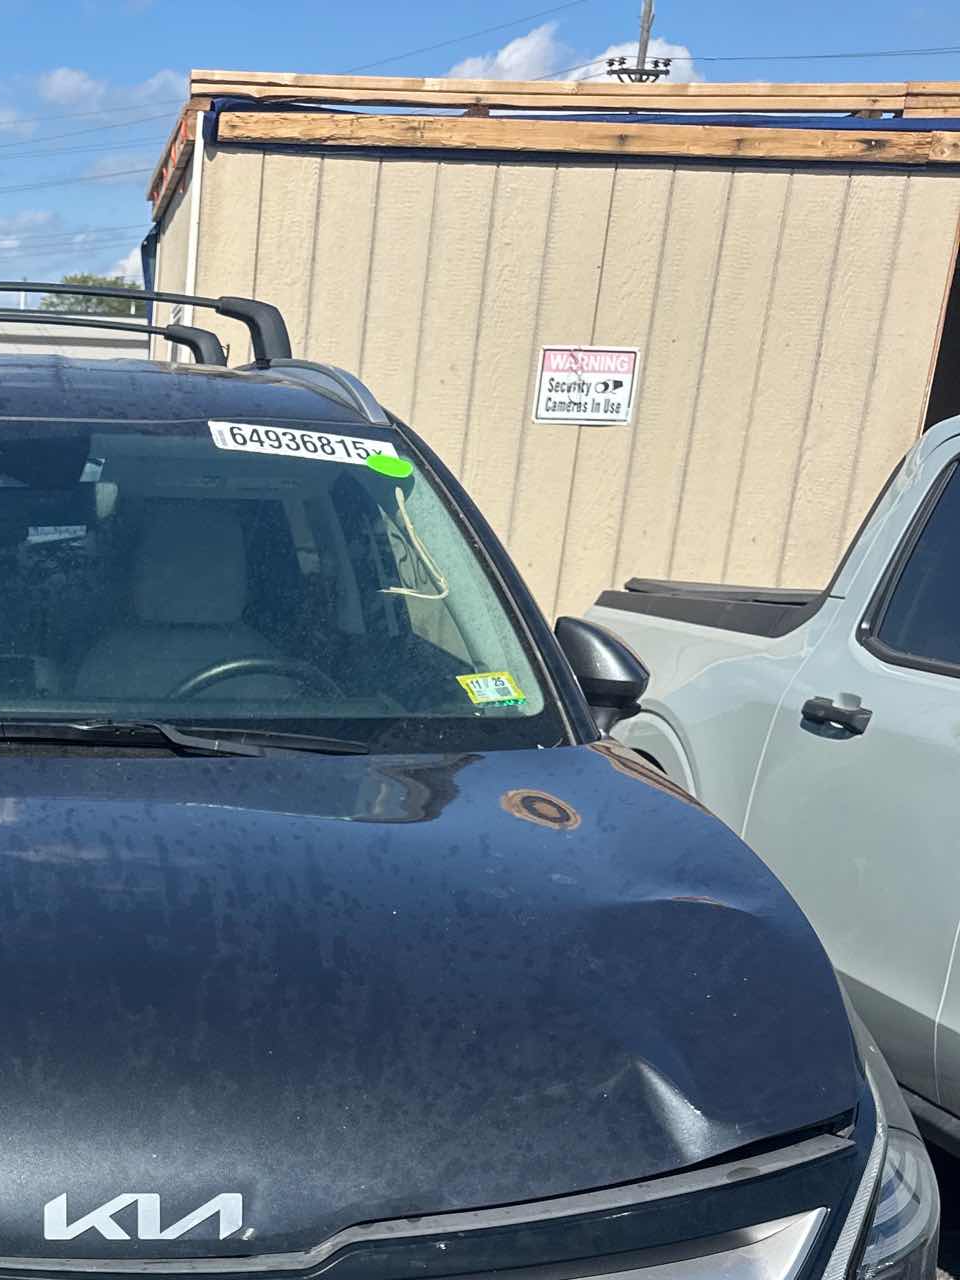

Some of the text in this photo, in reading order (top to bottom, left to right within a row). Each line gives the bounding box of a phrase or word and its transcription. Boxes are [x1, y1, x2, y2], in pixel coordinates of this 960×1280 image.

[550, 352, 629, 372] WARNING
[547, 377, 592, 397] Security
[545, 397, 622, 414] Cameras In Use
[44, 1192, 242, 1240] KIA
